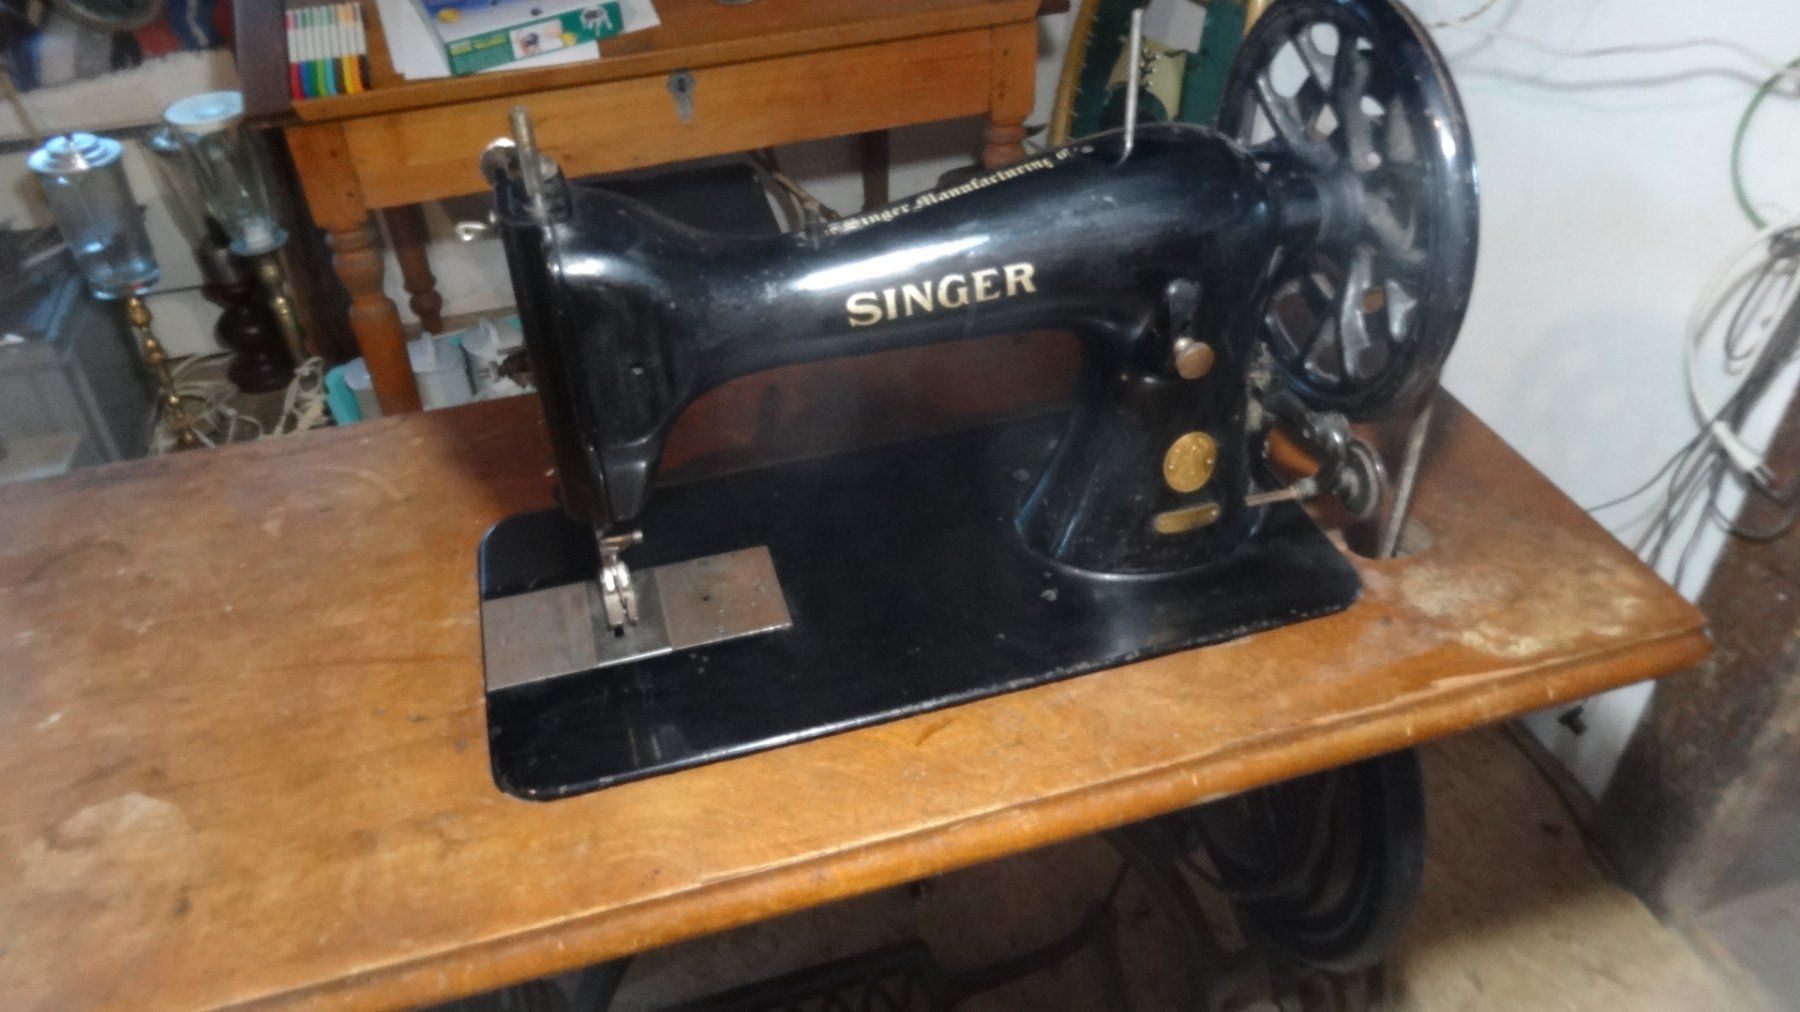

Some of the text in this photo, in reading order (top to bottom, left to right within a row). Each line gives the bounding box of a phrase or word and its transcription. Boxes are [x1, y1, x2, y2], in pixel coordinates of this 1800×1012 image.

[842, 203, 909, 233] Singer
[912, 158, 1054, 212] Manufacturing
[846, 262, 1036, 327] SINGER
